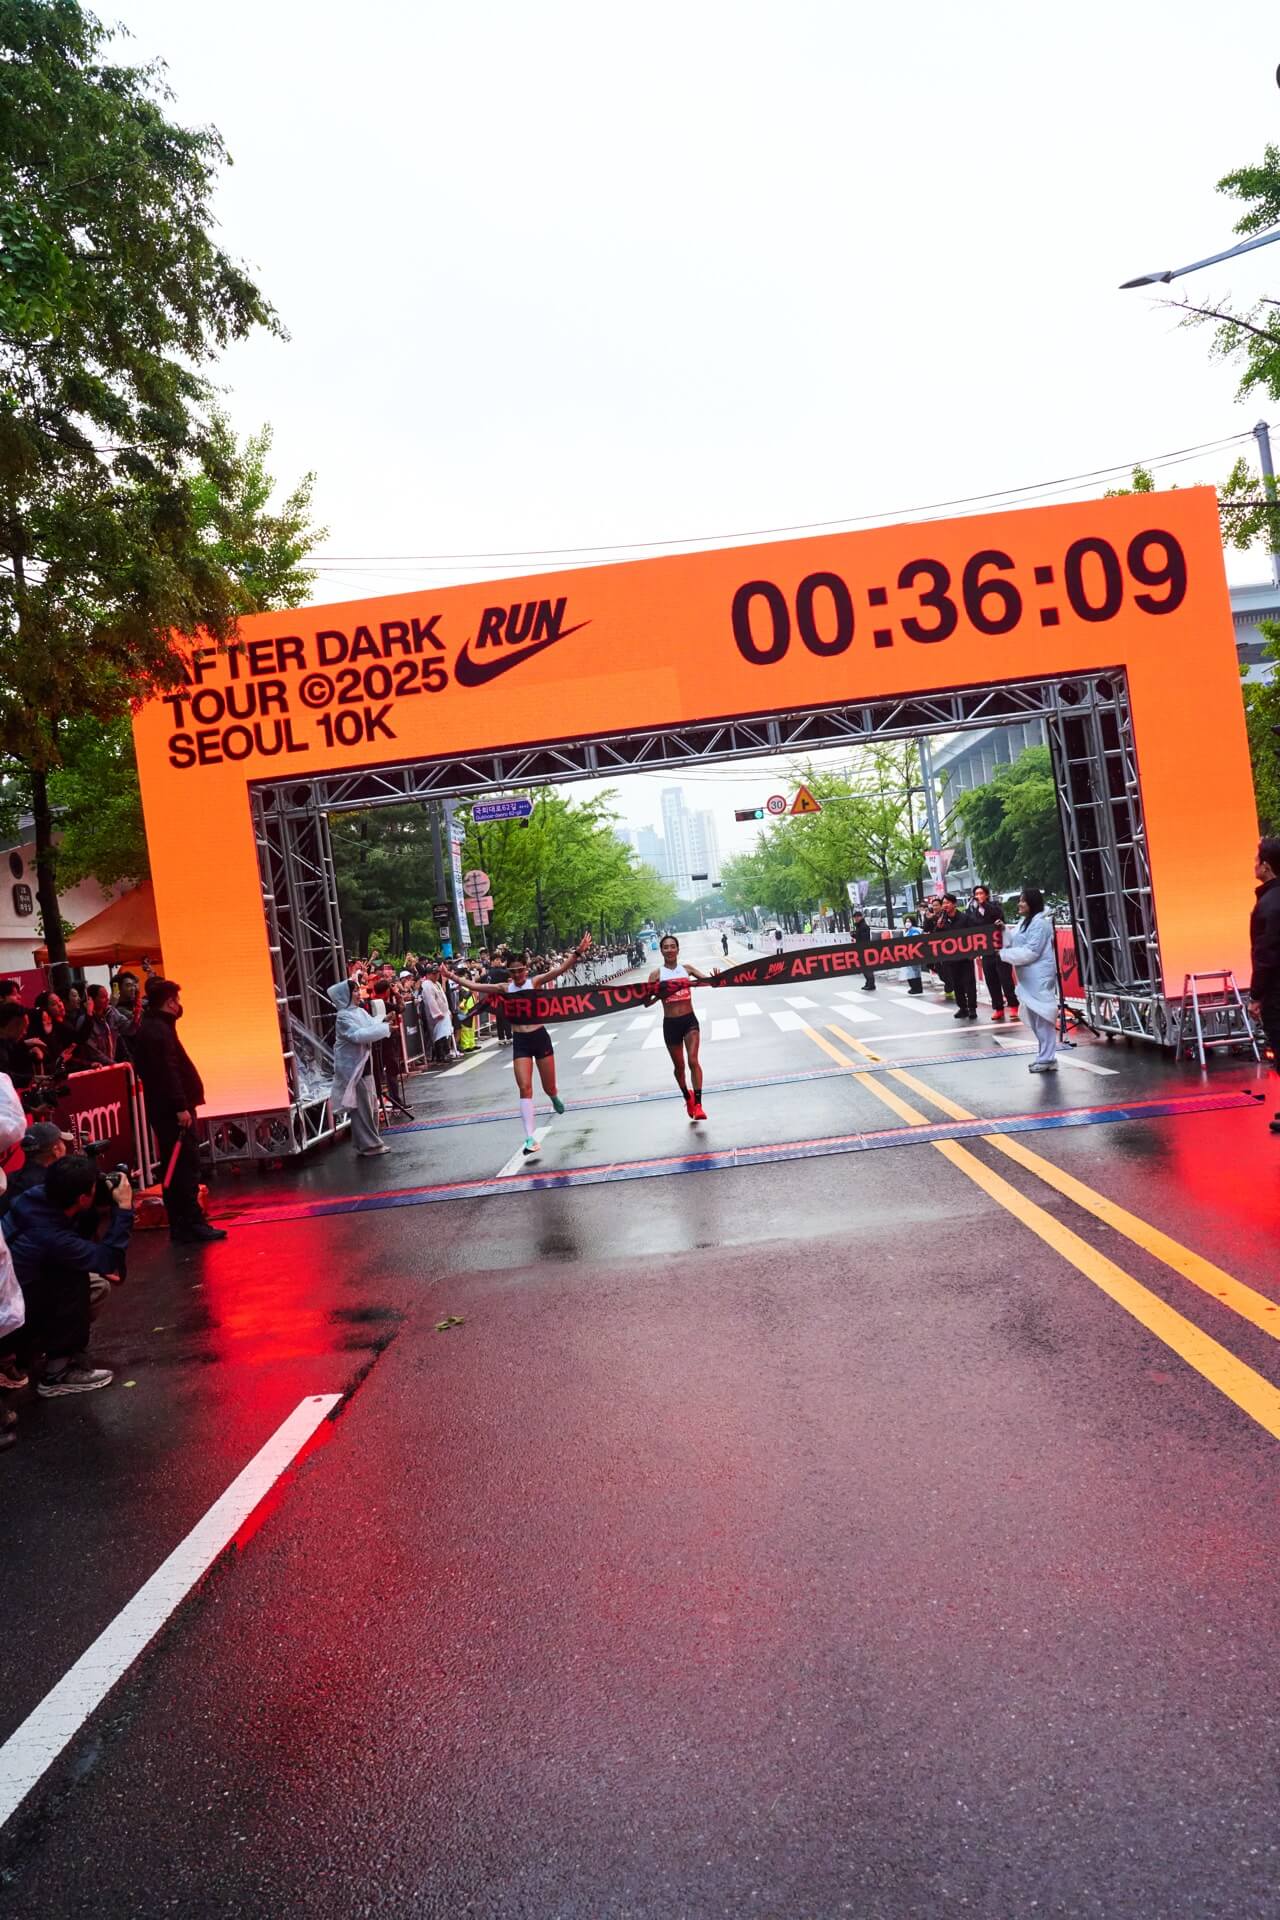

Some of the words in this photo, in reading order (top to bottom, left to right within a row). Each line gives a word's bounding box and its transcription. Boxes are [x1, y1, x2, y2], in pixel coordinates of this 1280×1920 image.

[477, 597, 567, 648] RUN
[731, 529, 1187, 665] 00:36:09
[316, 614, 445, 667] DARK
[162, 680, 289, 729] TOUR
[299, 656, 448, 709] ©2025
[168, 718, 309, 769] SEOUL
[316, 704, 397, 747] 10K
[771, 800, 783, 810] 30
[791, 949, 860, 977] AFTER
[863, 942, 923, 968] DARK
[929, 930, 989, 957] TOUR
[536, 992, 596, 1018] DARK
